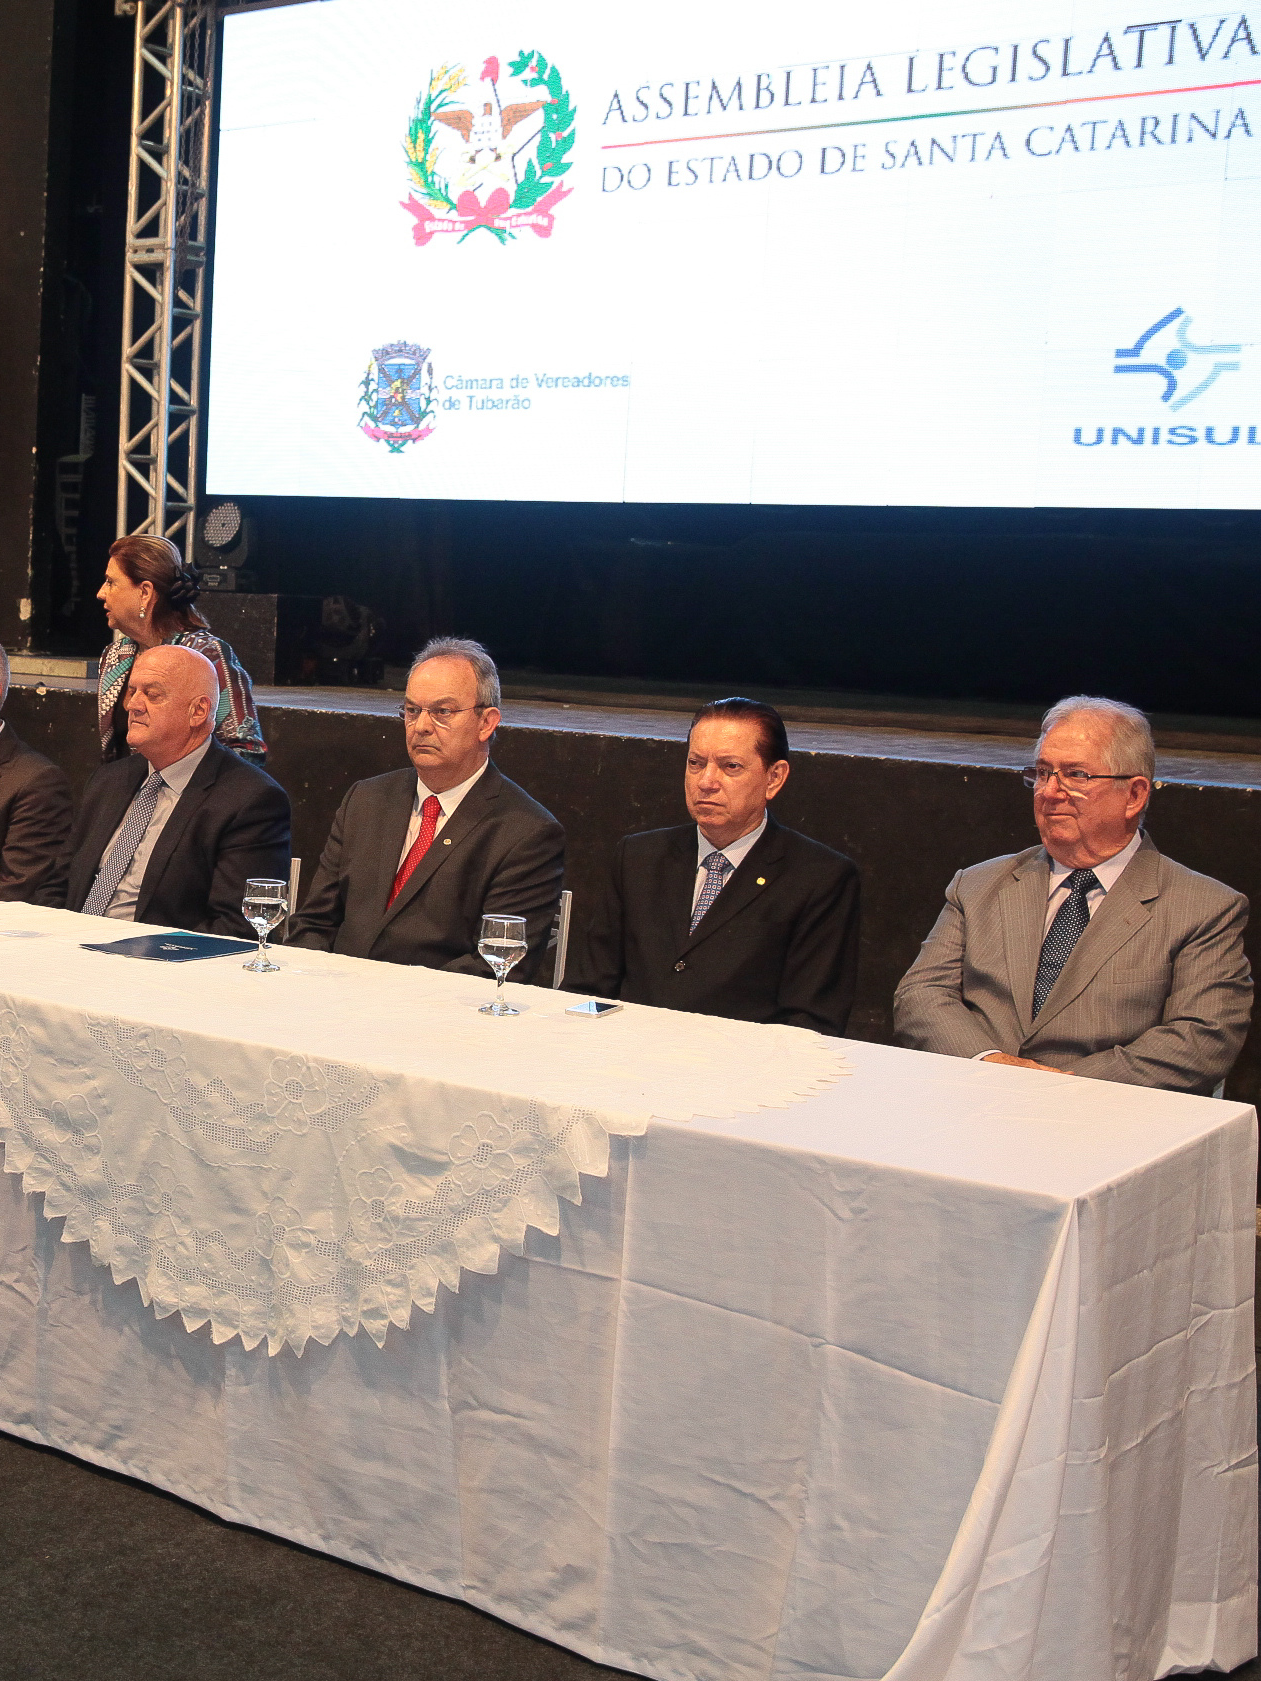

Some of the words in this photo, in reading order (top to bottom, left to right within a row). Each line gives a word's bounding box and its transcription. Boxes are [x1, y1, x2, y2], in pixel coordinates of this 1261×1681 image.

[601, 61, 884, 126] ASSEMBLEIA
[906, 14, 1261, 94] LEGISLATIVA
[601, 163, 652, 193] DO
[667, 150, 804, 187] ESTADO
[820, 143, 867, 175] DE
[881, 131, 1010, 170] SANTA
[1025, 107, 1254, 157] CATARINA
[443, 375, 504, 390] Câmara
[509, 373, 530, 389] de
[534, 372, 629, 389] Vereadores
[442, 396, 461, 411] de
[466, 395, 531, 411] Tubarão
[1072, 424, 1261, 447] UNISUL
